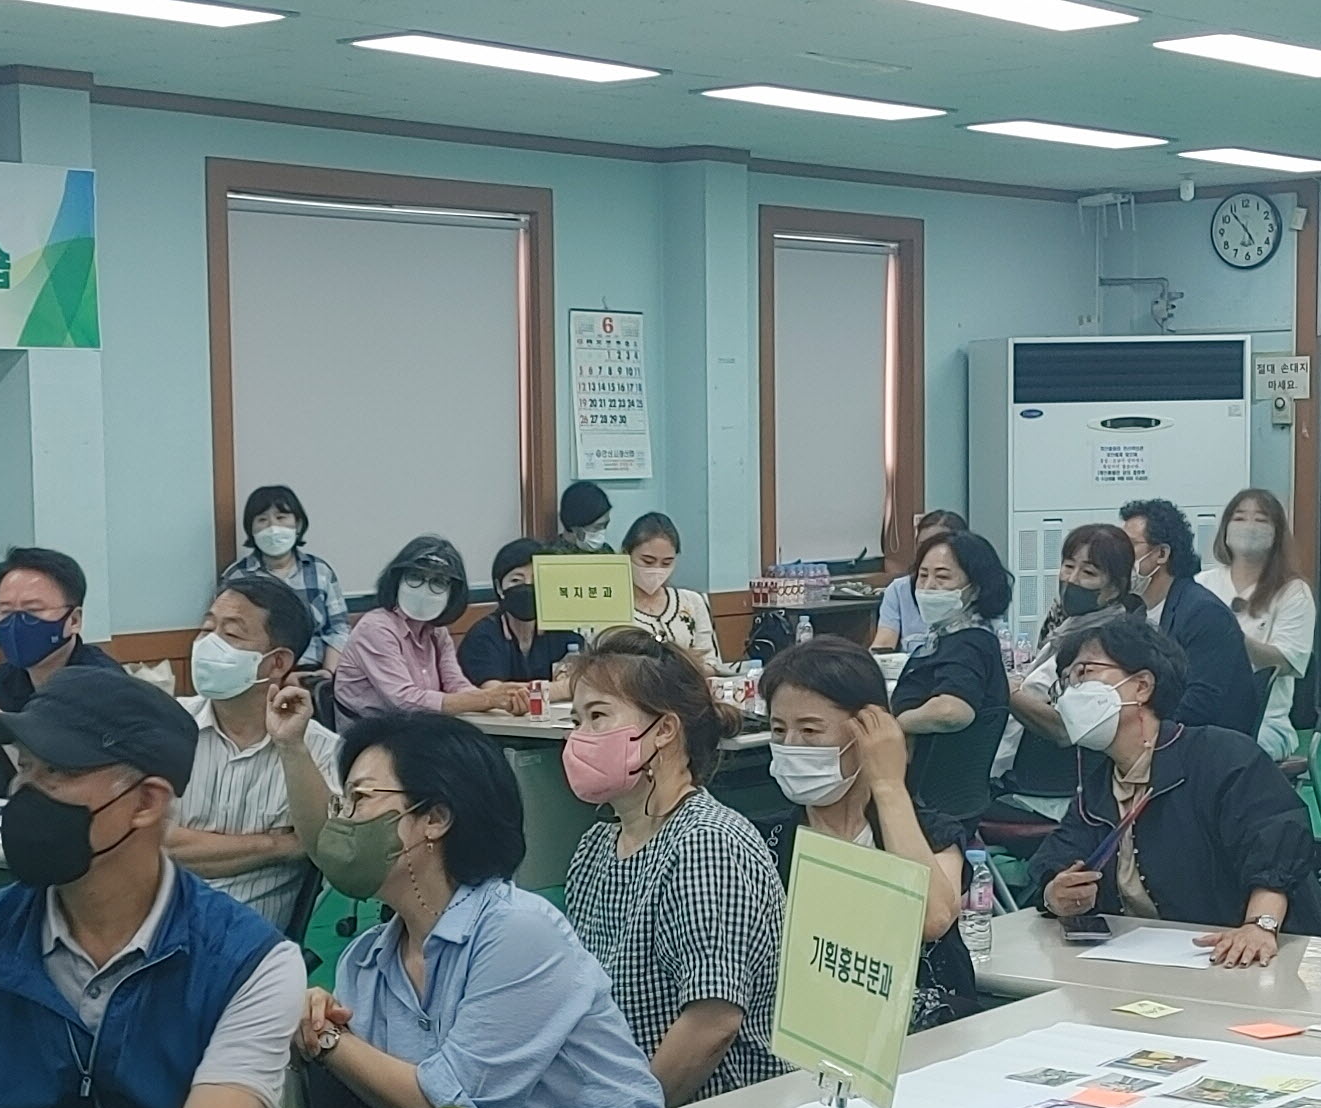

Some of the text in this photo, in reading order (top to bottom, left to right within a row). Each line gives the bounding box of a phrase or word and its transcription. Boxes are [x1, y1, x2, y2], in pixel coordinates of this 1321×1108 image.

[1241, 198, 1251, 209] 12
[1256, 201, 1260, 212] 1
[1222, 214, 1231, 225] 10
[1263, 210, 1270, 220] 2
[1218, 227, 1226, 237] 9
[1267, 223, 1274, 233] 3
[1223, 240, 1230, 250] 8
[1264, 236, 1270, 245] 4
[1232, 248, 1239, 258] 7
[1244, 251, 1251, 261] 6
[1256, 246, 1263, 256] 5
[602, 316, 614, 334] 6
[1256, 361, 1308, 375] 절대 손대지
[809, 935, 894, 1002] 기획홍보분과
